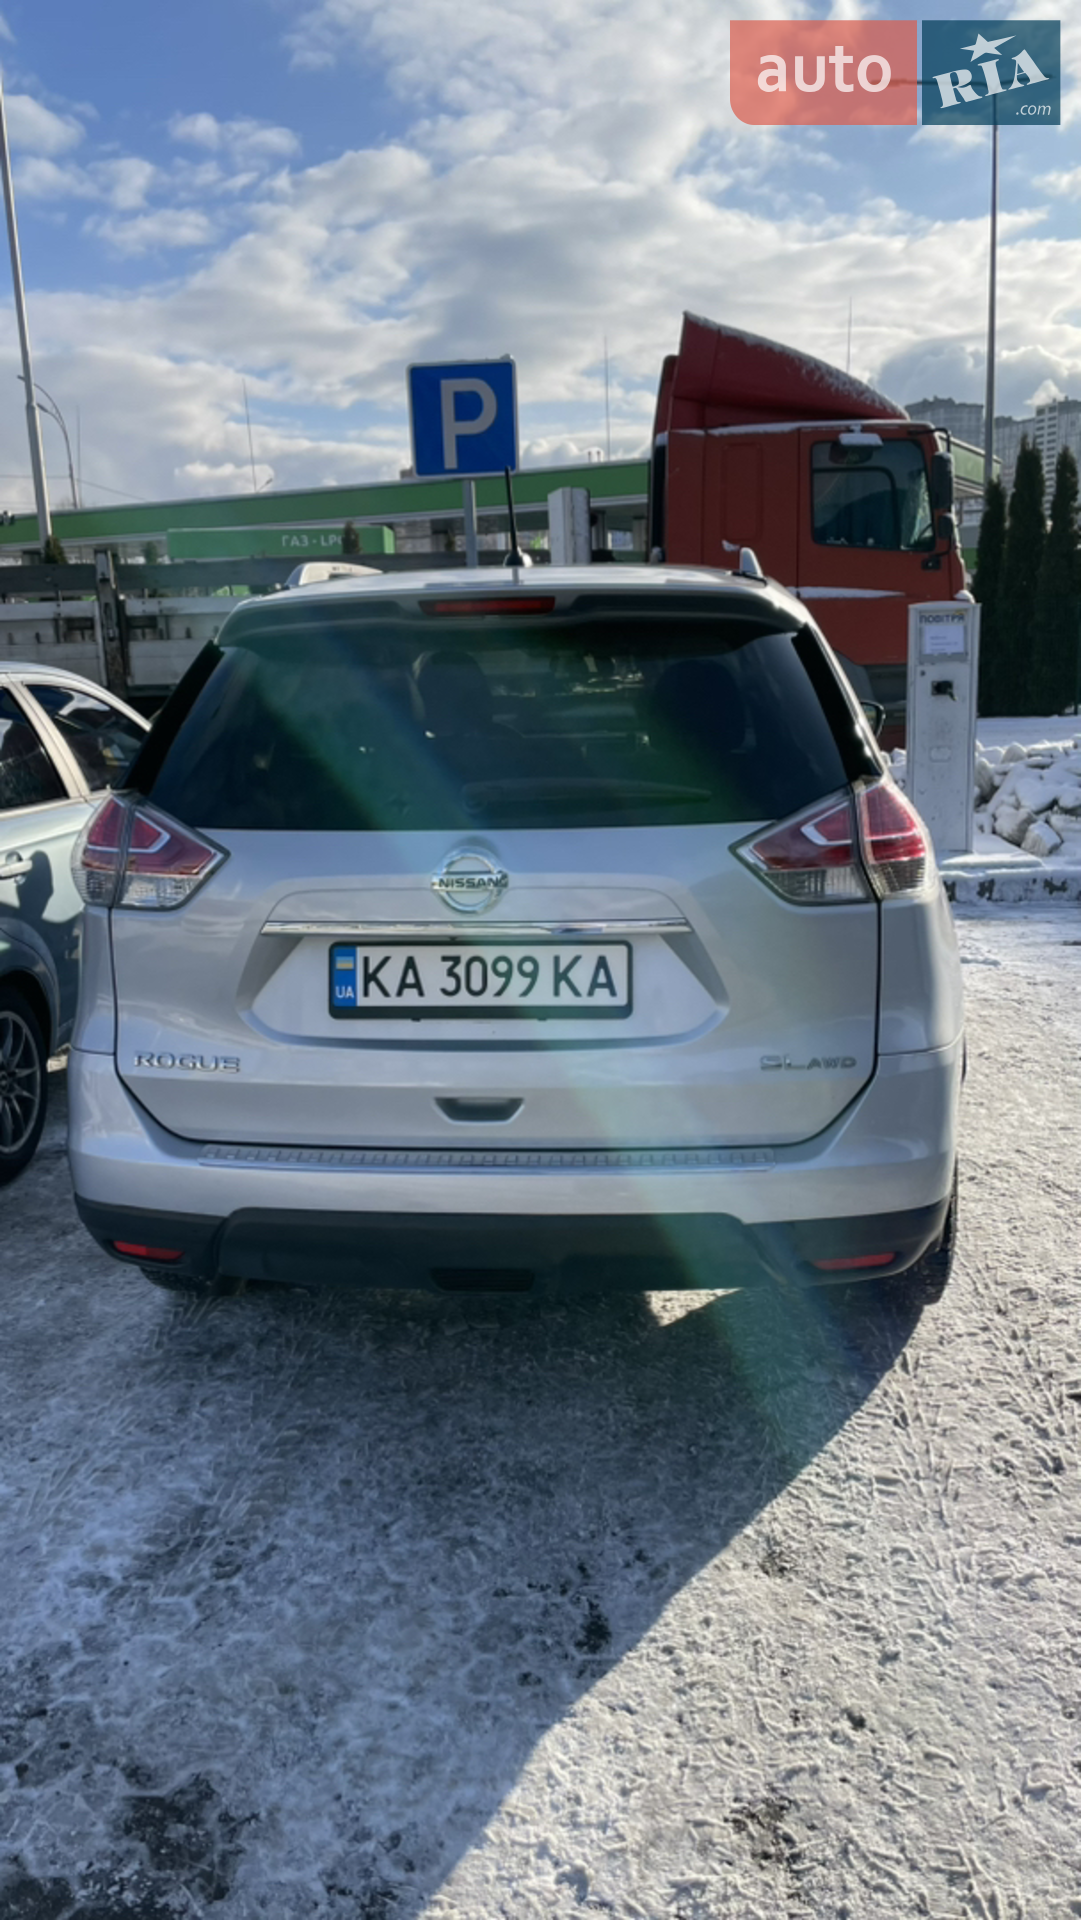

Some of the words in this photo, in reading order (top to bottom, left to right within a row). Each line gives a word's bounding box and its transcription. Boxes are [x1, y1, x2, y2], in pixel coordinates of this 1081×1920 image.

[441, 378, 498, 470] P
[282, 535, 309, 547] ГАЗ
[439, 877, 501, 889] NISSAN
[363, 956, 425, 998] KA
[440, 955, 540, 997] 3099
[553, 955, 618, 997] KA
[335, 986, 355, 999] UA
[134, 1050, 240, 1074] ROGUE
[806, 1056, 857, 1070] AWD
